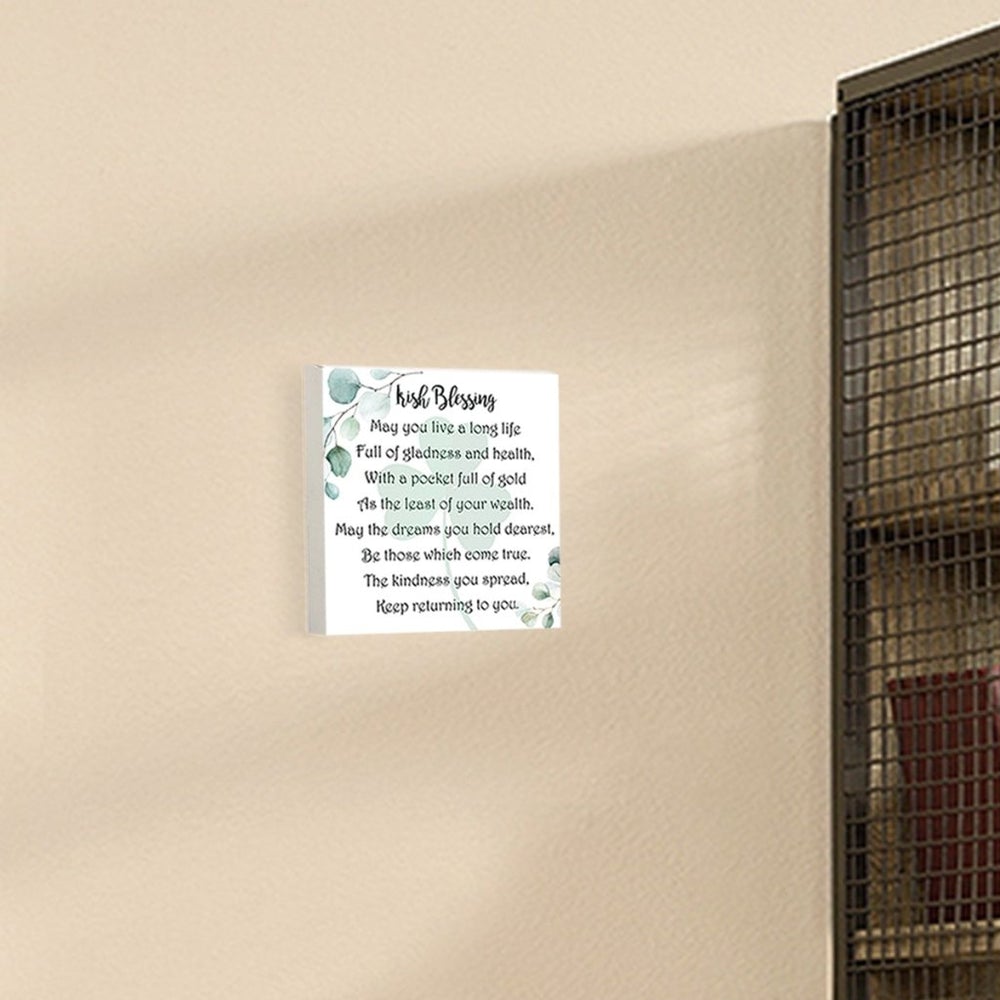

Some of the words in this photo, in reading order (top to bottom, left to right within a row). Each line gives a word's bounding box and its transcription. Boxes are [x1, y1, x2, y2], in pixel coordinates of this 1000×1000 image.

[431, 384, 497, 413] Blessing
[370, 419, 398, 437] May
[403, 421, 427, 437] you
[431, 420, 454, 435] live
[458, 423, 466, 434] a
[470, 421, 499, 438] long
[501, 422, 521, 438] life
[356, 444, 382, 459] Full
[385, 446, 400, 462] of
[402, 446, 462, 462] gladness
[465, 447, 489, 460] and
[365, 470, 395, 485] With
[399, 474, 407, 485] a
[411, 471, 454, 487] pocket
[458, 472, 478, 488] full
[482, 472, 495, 487] of
[498, 472, 527, 488] gold
[357, 497, 377, 512] As
[381, 497, 401, 511] the
[405, 497, 436, 511] least
[439, 498, 452, 512] of
[456, 500, 488, 513] your
[335, 523, 363, 539] May
[368, 523, 388, 537] the
[391, 523, 441, 537] dreams
[444, 525, 469, 539] you
[473, 523, 501, 536] hold
[361, 548, 381, 563] Be
[384, 548, 420, 562] those
[424, 548, 461, 561] which
[465, 551, 499, 561] come
[502, 549, 531, 561] true.
[363, 573, 388, 588] The
[391, 574, 450, 588] kindness
[454, 575, 479, 589] you
[376, 600, 409, 616] Keep
[412, 599, 473, 614] returning
[477, 598, 490, 611] to
[492, 600, 519, 613] you.
